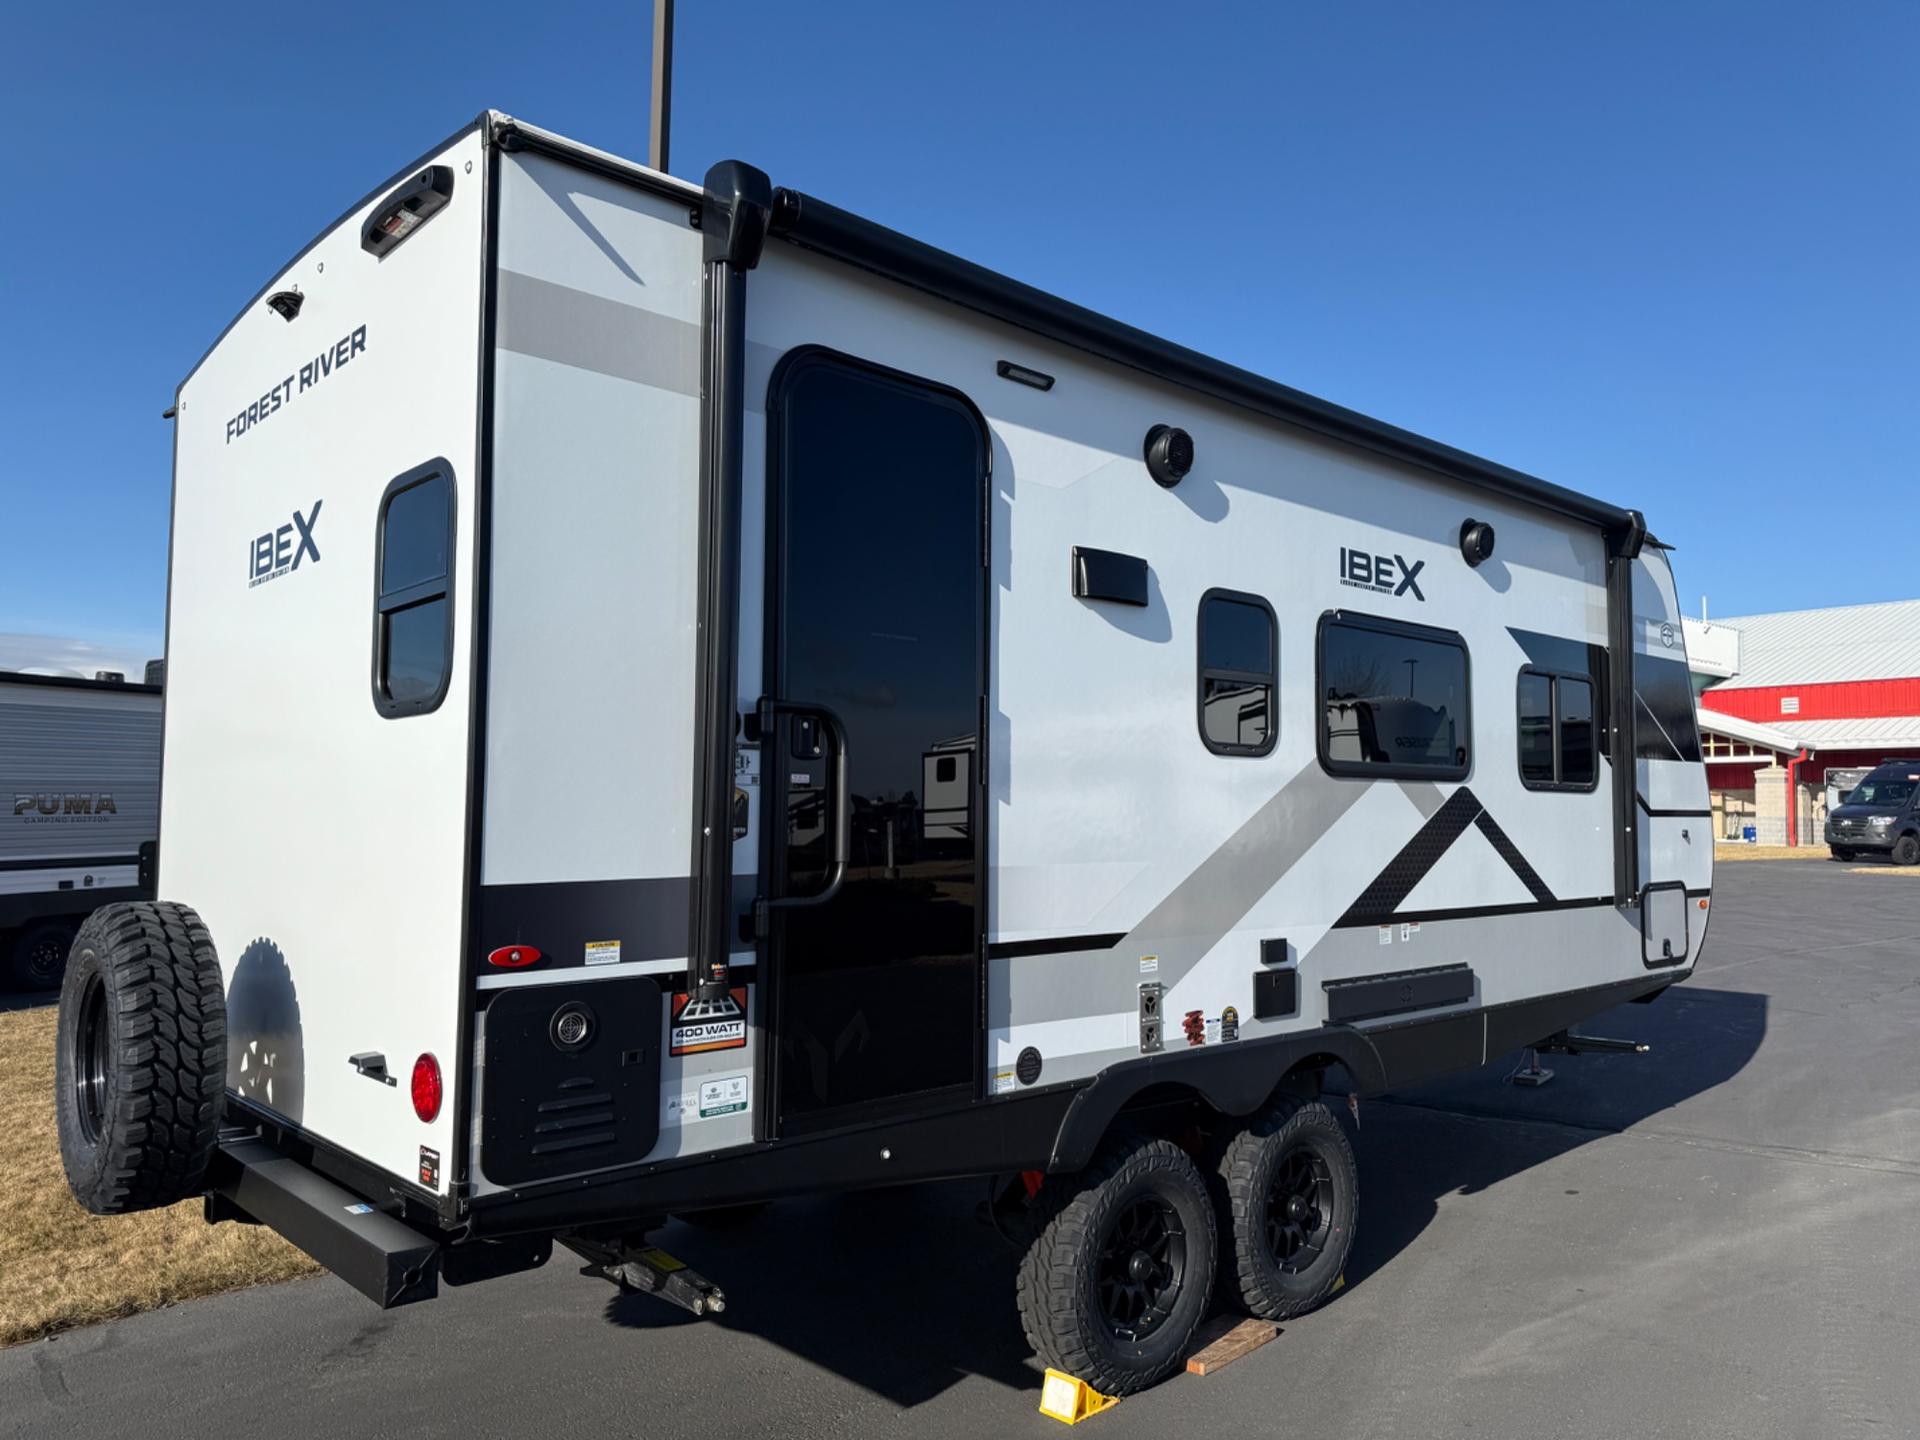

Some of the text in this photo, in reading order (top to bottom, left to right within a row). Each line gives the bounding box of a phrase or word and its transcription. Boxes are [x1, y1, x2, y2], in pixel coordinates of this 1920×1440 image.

[226, 323, 367, 445] FOREST RIVER
[249, 498, 323, 580] IBEX
[1340, 546, 1426, 602] IBEX
[13, 793, 117, 815] PUMA
[676, 1027, 703, 1039] 400
[705, 1022, 741, 1035] WATT
